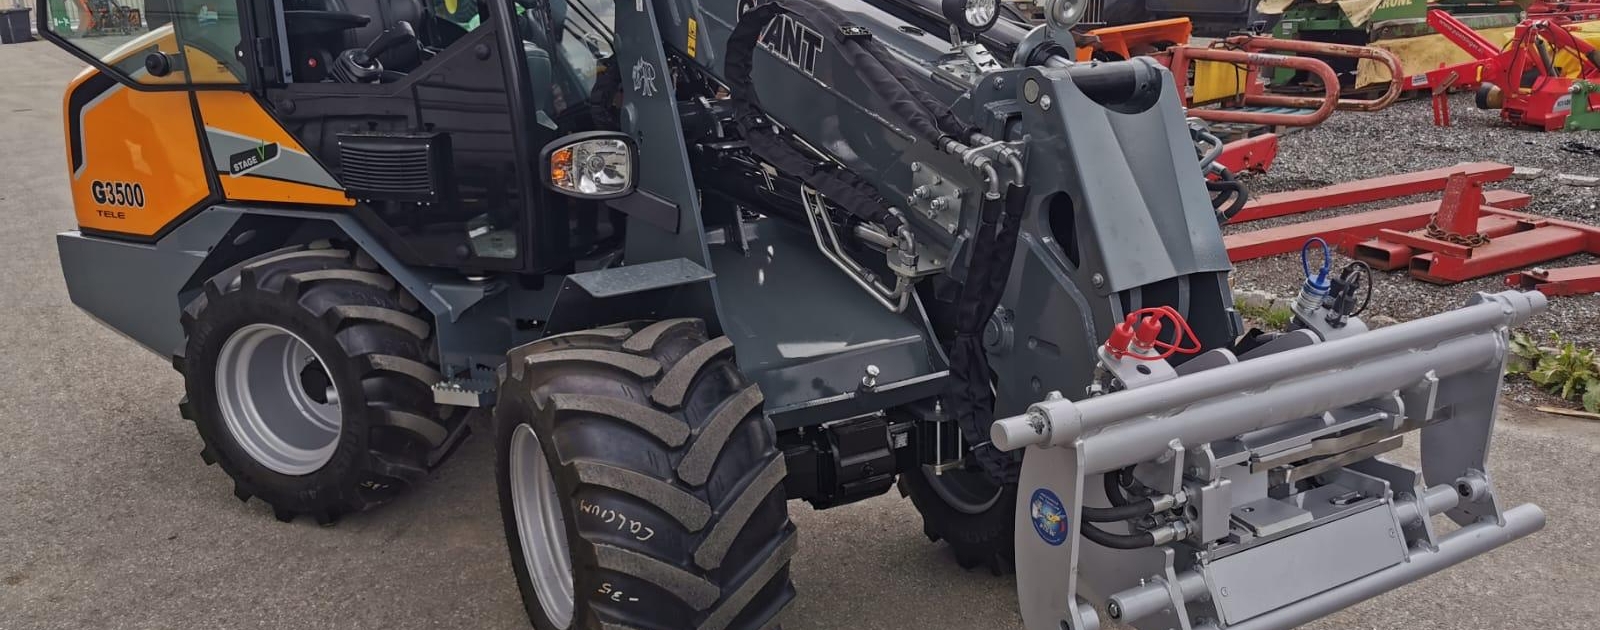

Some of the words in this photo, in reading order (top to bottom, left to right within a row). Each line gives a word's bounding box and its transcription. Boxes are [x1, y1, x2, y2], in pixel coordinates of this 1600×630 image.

[233, 155, 259, 172] STAGE
[91, 179, 145, 209] G3500
[96, 209, 126, 220] TELE
